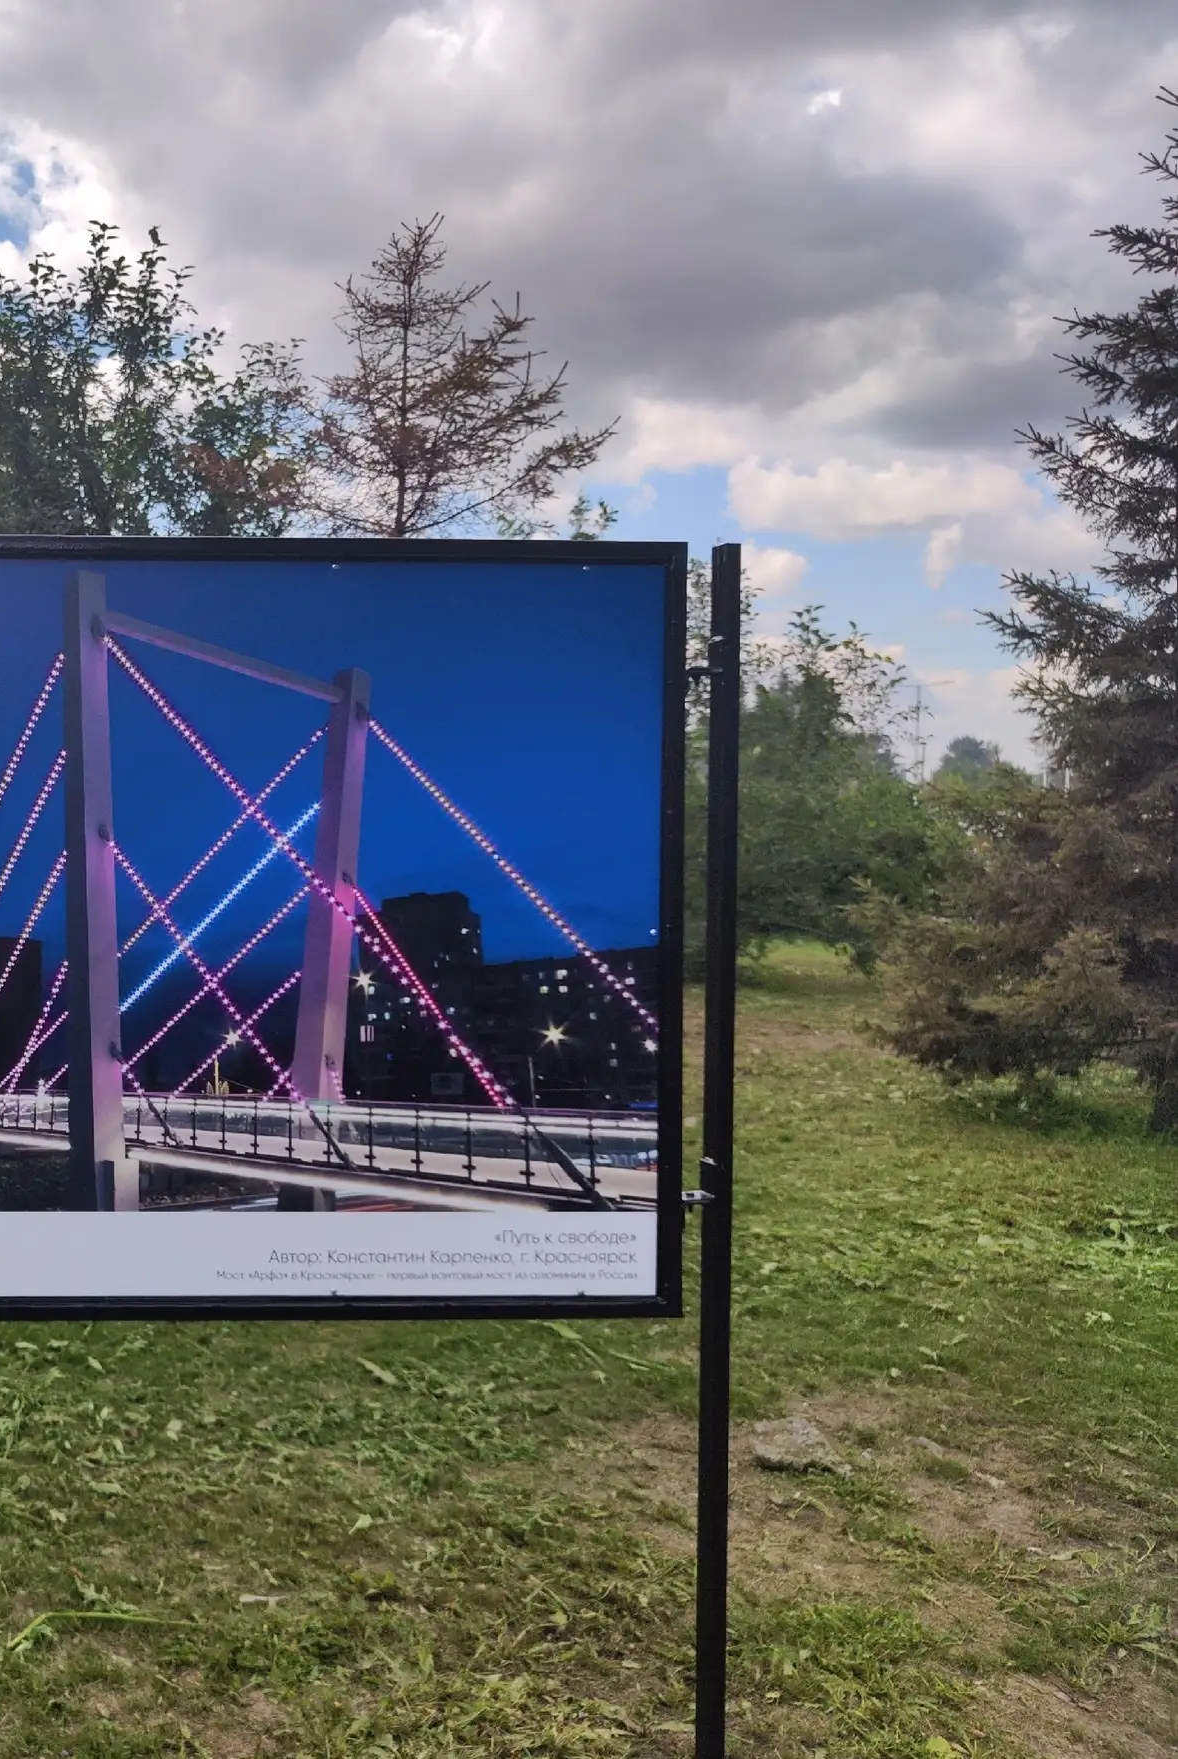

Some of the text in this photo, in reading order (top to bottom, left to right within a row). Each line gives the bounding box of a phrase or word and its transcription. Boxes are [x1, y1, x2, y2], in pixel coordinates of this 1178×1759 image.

[494, 1229, 637, 1247] «Путь к свободе»
[268, 1249, 638, 1266] Автор: Константин Карпенко, г. Красноярск
[216, 1270, 244, 1280] Мост
[248, 1270, 288, 1282] «Арфа»
[291, 1272, 298, 1280] в
[300, 1270, 375, 1282] Красноярске
[486, 1272, 512, 1280] мост
[598, 1269, 638, 1280] России
